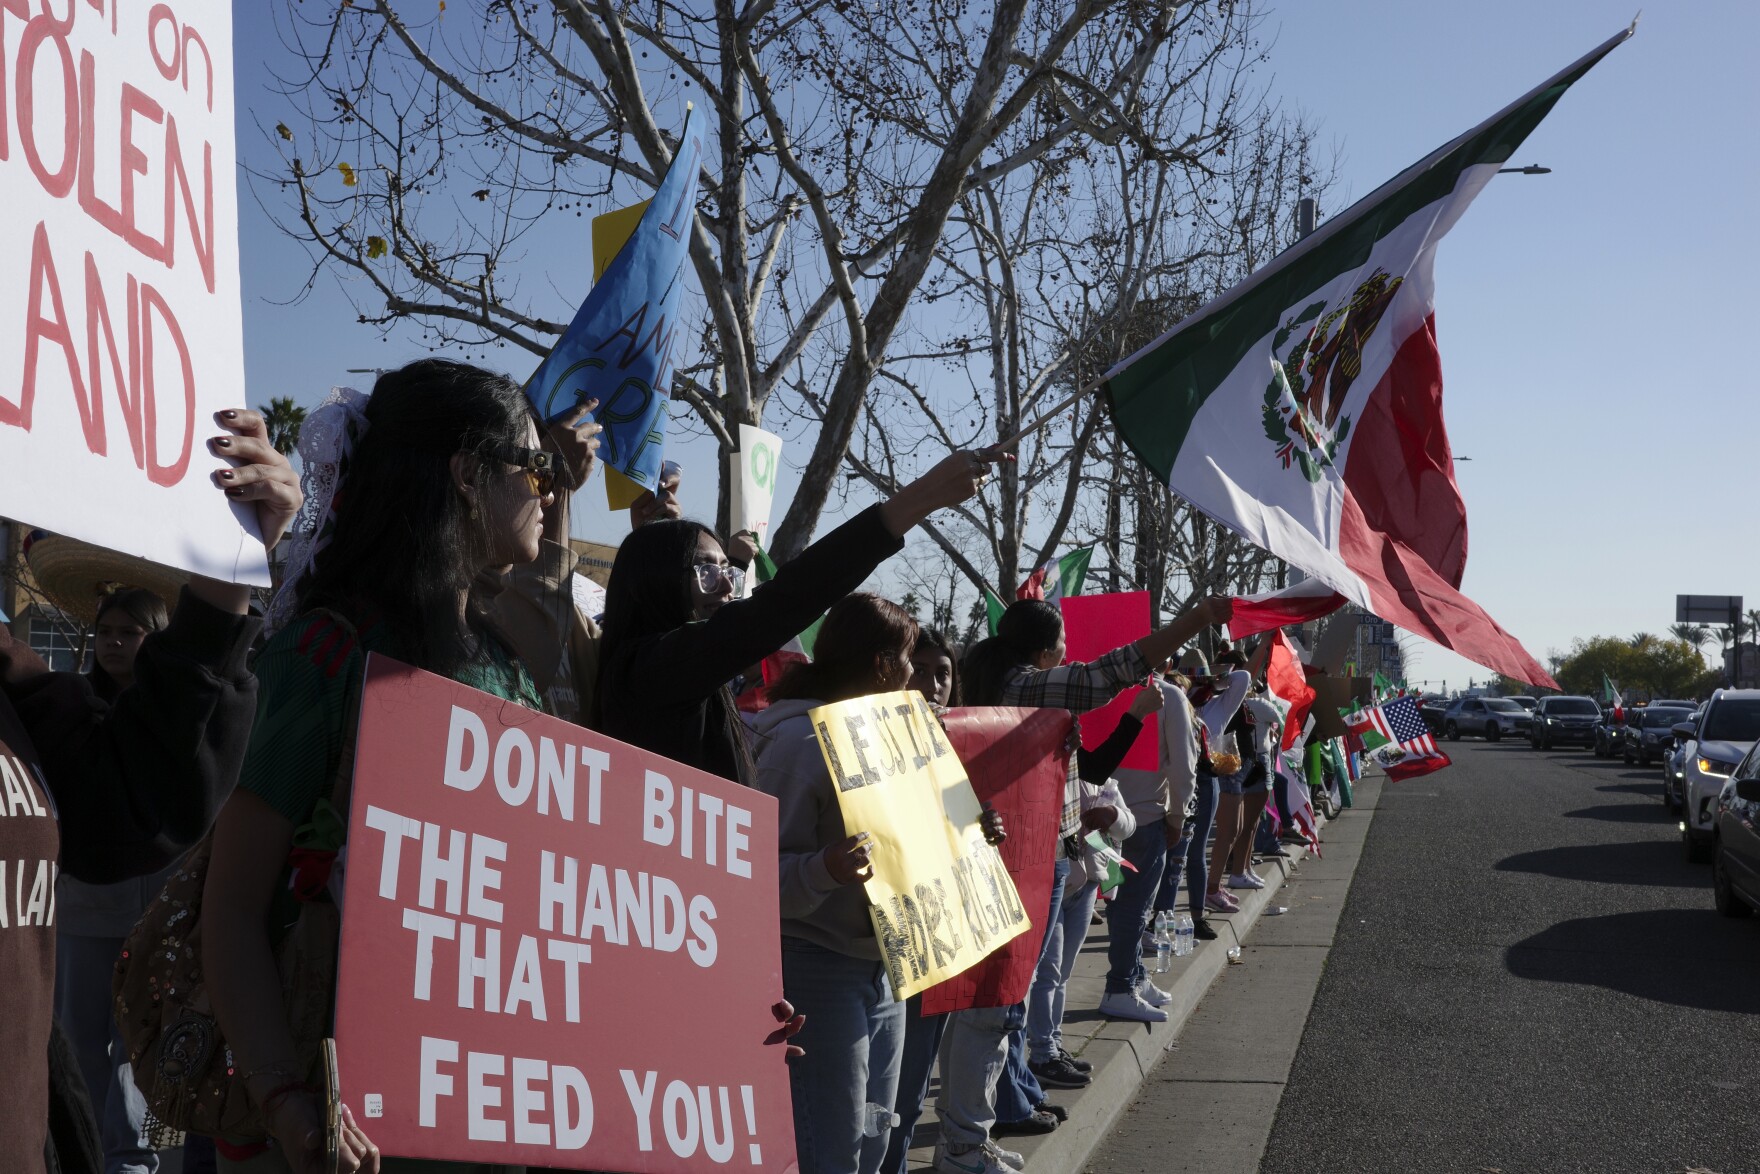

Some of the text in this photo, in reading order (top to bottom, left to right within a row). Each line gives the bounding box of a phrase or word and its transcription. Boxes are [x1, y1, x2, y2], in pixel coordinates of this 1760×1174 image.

[148, 3, 213, 113] on
[0, 220, 196, 488] AND
[444, 705, 752, 879] DONT BITE
[366, 805, 718, 968] THE HANDS
[872, 877, 964, 990] MORE
[402, 908, 592, 1023] THAT
[419, 1035, 763, 1165] FEED YOU!
